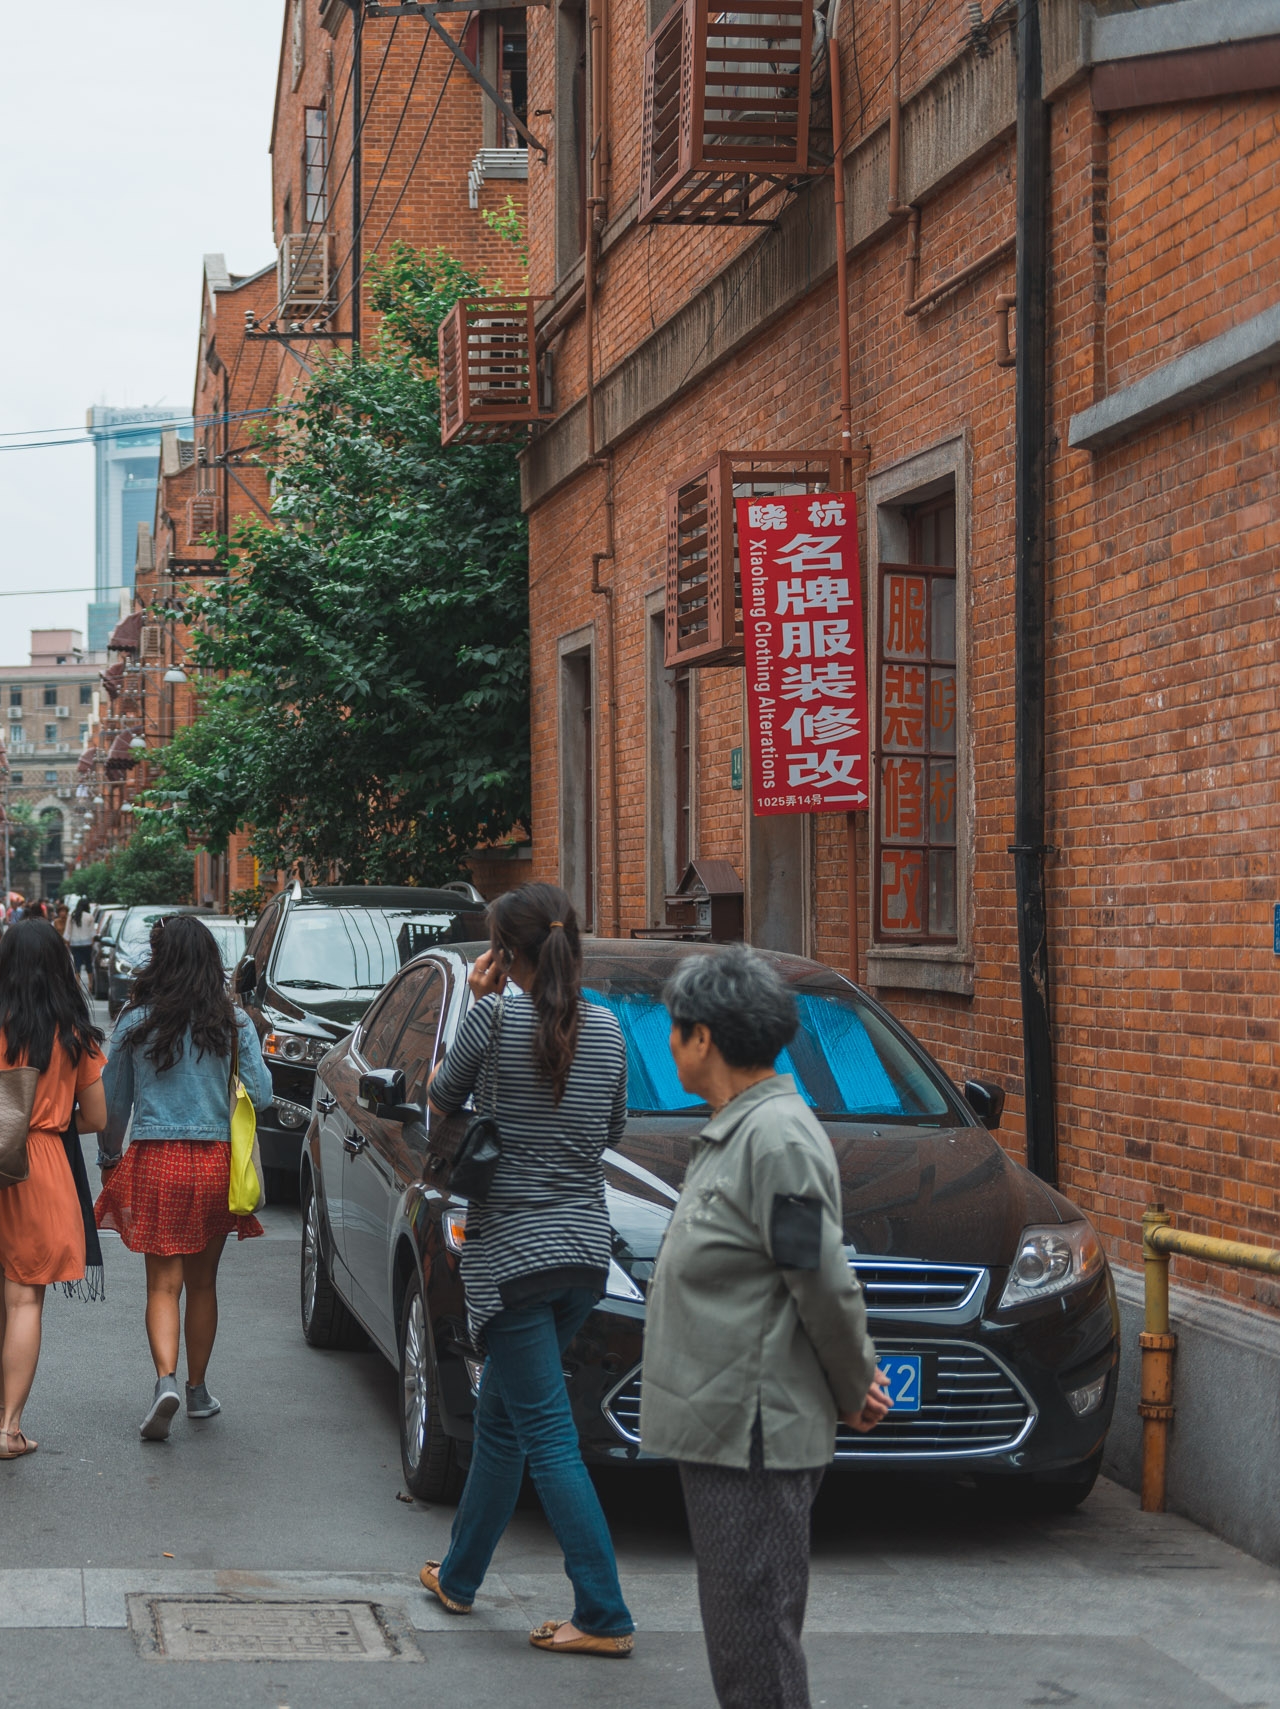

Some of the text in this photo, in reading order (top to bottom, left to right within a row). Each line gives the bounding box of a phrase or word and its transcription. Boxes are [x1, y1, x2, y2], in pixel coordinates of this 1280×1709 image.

[749, 539, 778, 789] Xiaohang Clothing Alterations
[772, 533, 864, 788] 名牌服装修改
[757, 794, 823, 807] 1025弄14号
